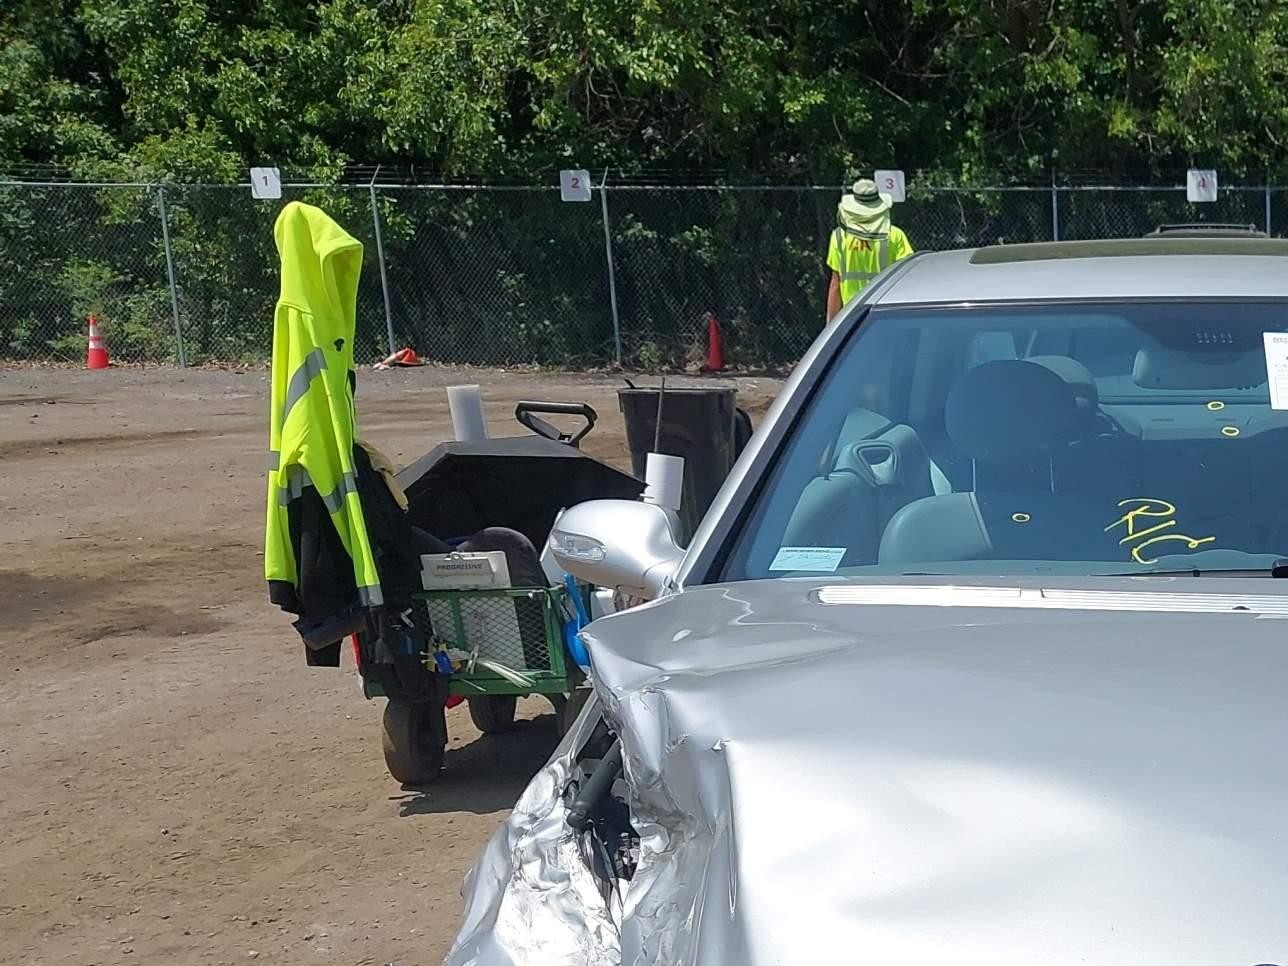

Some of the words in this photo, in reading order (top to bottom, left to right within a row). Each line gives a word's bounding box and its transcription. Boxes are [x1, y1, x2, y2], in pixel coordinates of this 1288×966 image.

[262, 175, 269, 187] 1
[570, 177, 580, 189] 2
[885, 178, 894, 190] 3
[1197, 176, 1206, 188] 4
